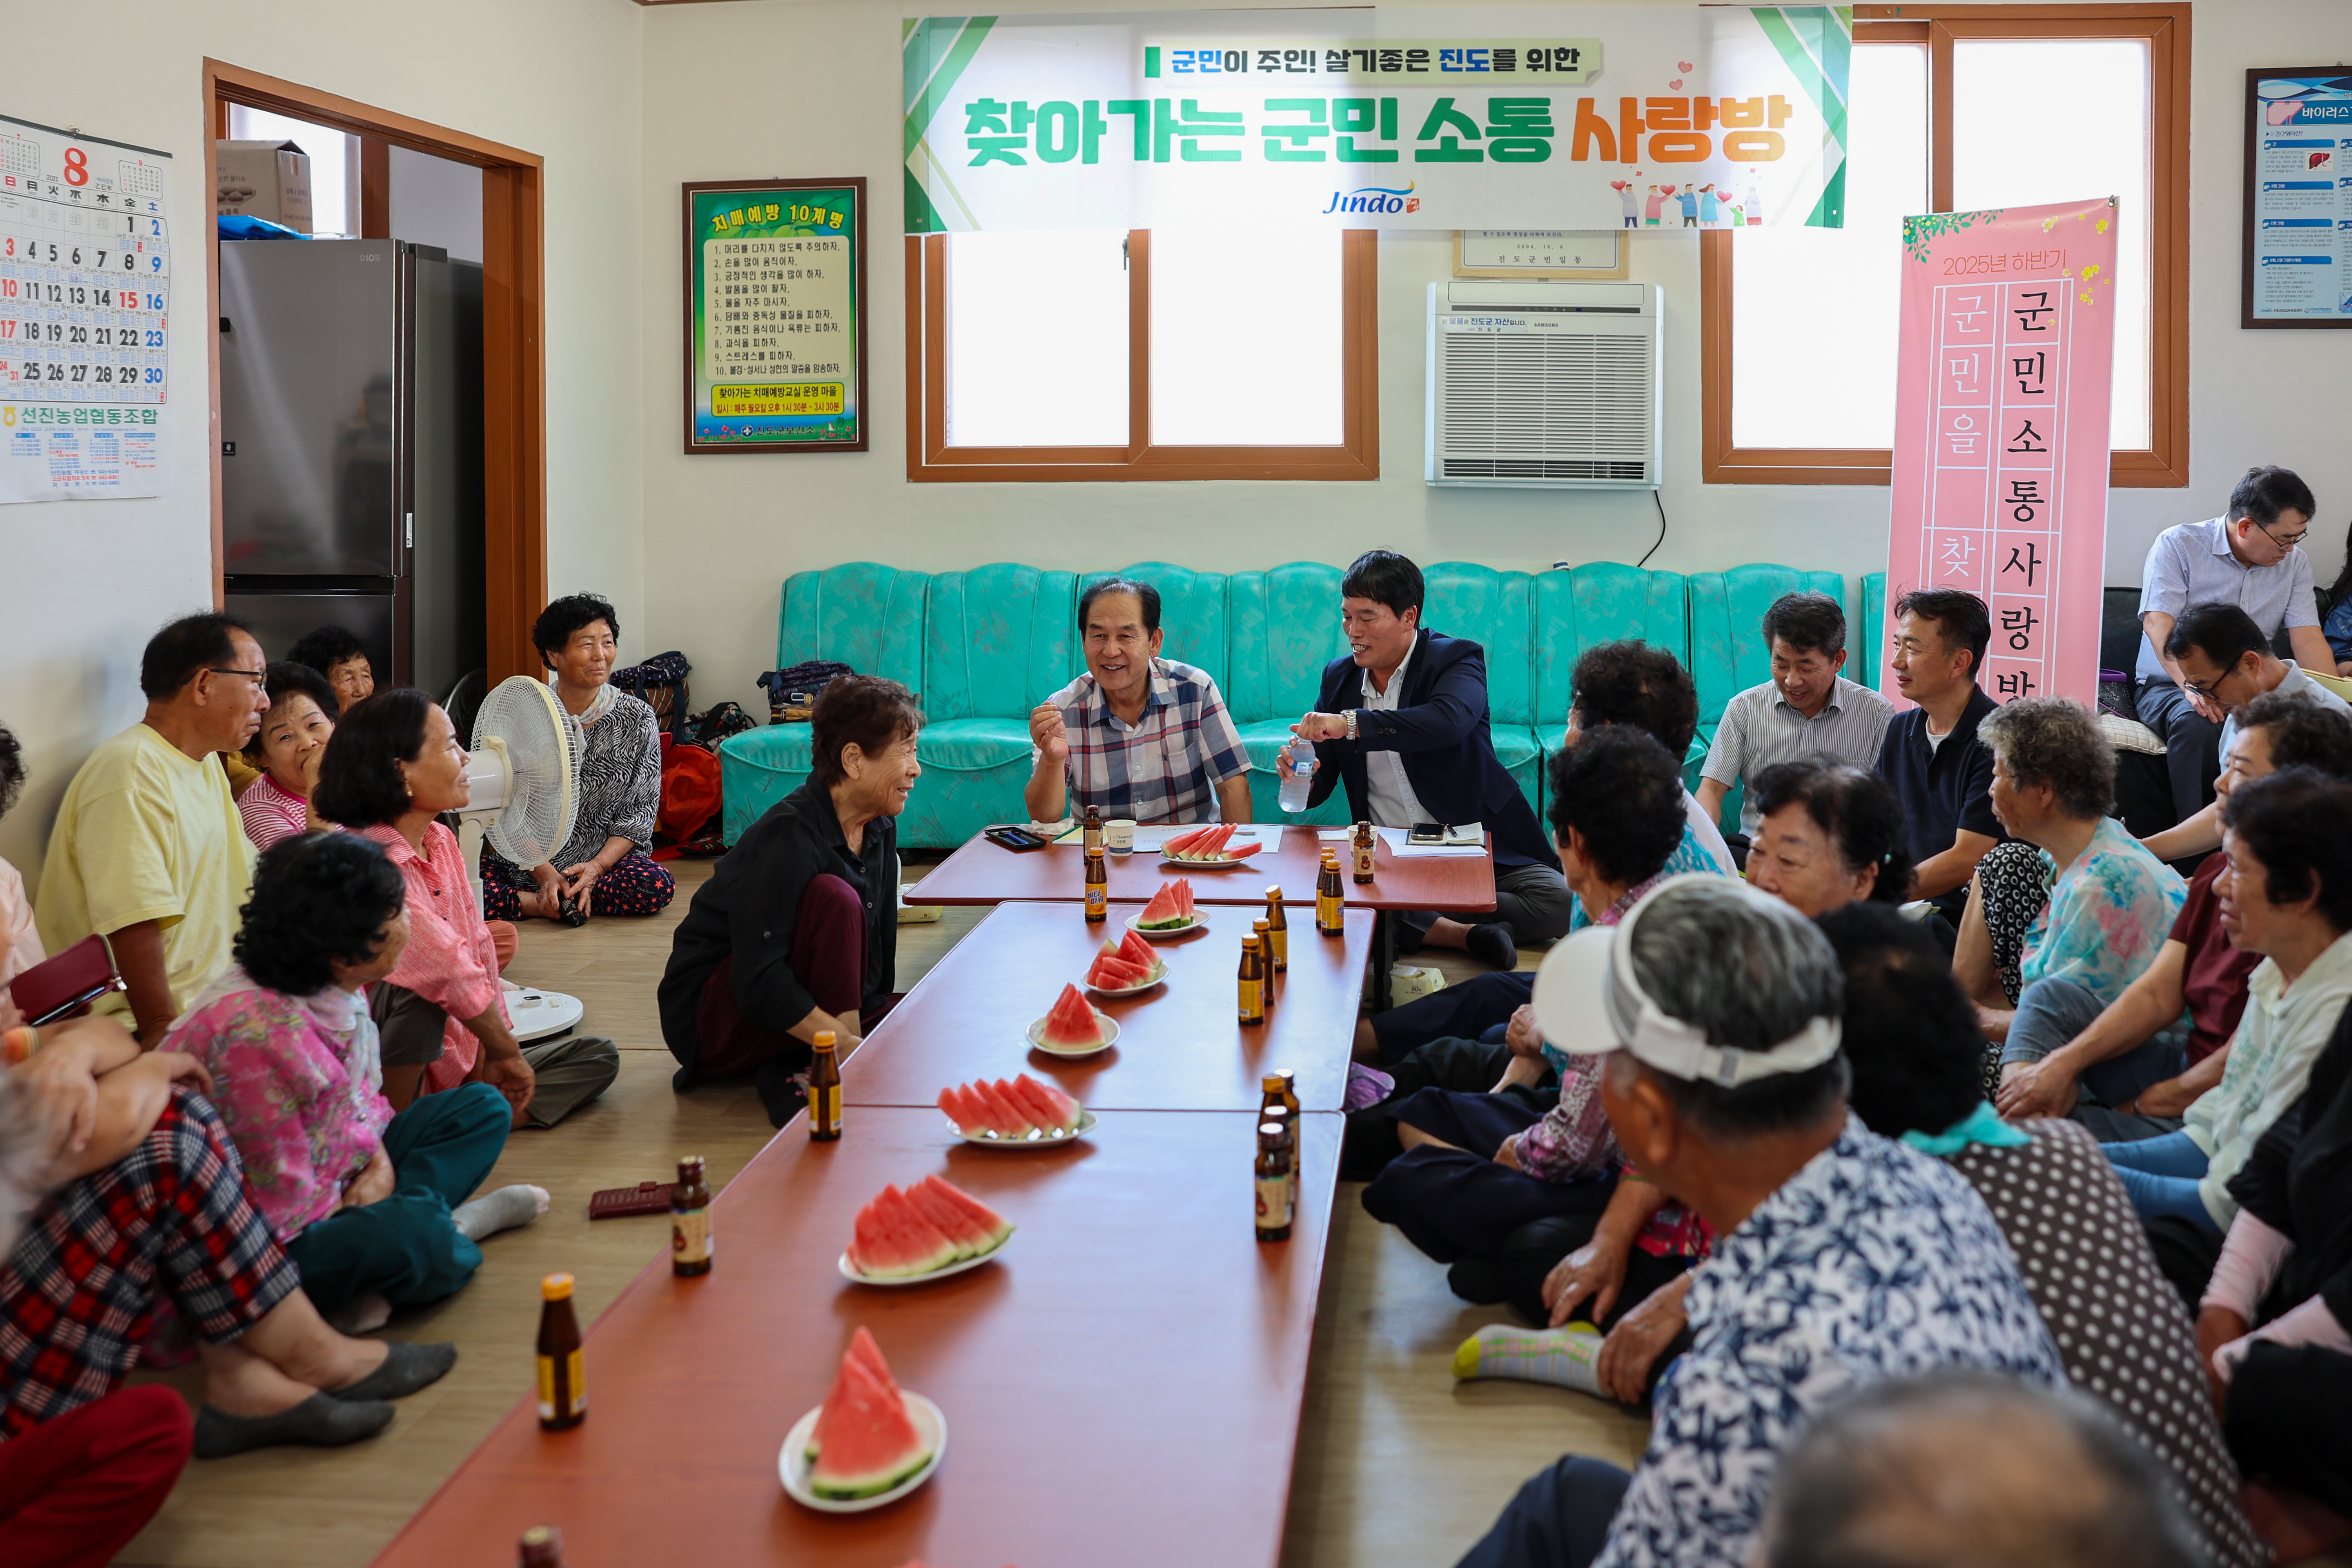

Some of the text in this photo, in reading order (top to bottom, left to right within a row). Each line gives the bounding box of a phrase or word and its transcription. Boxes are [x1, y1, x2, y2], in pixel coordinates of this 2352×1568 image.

[1172, 47, 1580, 73] 군민이 주인! 살기좋은 진도를 위한
[2302, 107, 2352, 118] 바이러스
[964, 95, 1792, 167] 찾아가는 군민 소통 사랑방
[64, 147, 89, 187] 8
[5, 176, 158, 211] 日 月 火 水 木 金 土
[1322, 191, 1403, 213] Jindo
[711, 204, 845, 232] 치매예방 10계명
[128, 216, 133, 232] 1
[152, 219, 161, 236] 2
[715, 242, 840, 254] 1. 머리를 다치지 않도록 주의하자.
[6, 238, 162, 272] 3 4 5 6 7 8 9
[714, 256, 797, 268] 2. 손을 많이 움직이자.
[1943, 249, 2066, 276] 2025년 하반기
[715, 269, 824, 281] 3. 긍정적인 생각을 많이 하자.
[2, 279, 163, 310] 10 11 12 13 14 15 16
[714, 283, 789, 295] 4. 발품을 많이 팔자.
[715, 297, 789, 308] 5. 물을 자주 마시자.
[715, 309, 832, 321] 6. 담배와 중독성 물질을 피하자.
[1, 320, 163, 347] 17 18 19 20 21 22 23
[715, 323, 840, 335] 7. 기름진 음식이나 육류는 피하자.
[715, 338, 779, 348] 8. 과식을 피하자.
[715, 351, 795, 362] 9. 스트레스를 피하자.
[24, 362, 41, 380] 25
[47, 363, 64, 381] 26
[71, 365, 88, 382] 27
[95, 366, 112, 383] 28
[119, 367, 138, 383] 29
[145, 368, 163, 383] 30
[716, 363, 840, 375] 10. 불경·성서나 성현의 말씀을 암송하자.
[1945, 295, 1987, 454] 군민을
[10, 371, 18, 381] 31
[719, 386, 837, 399] 찾아가는 치매예방교실 운영 마을
[717, 402, 839, 414] 일시 매주 월요일 오후 1시 30분 3시 30분
[22, 407, 158, 425] 선진농업협동조합
[756, 426, 815, 436] 진도군보건소
[1087, 890, 1100, 899] 비타
[1090, 895, 1103, 905] 파워
